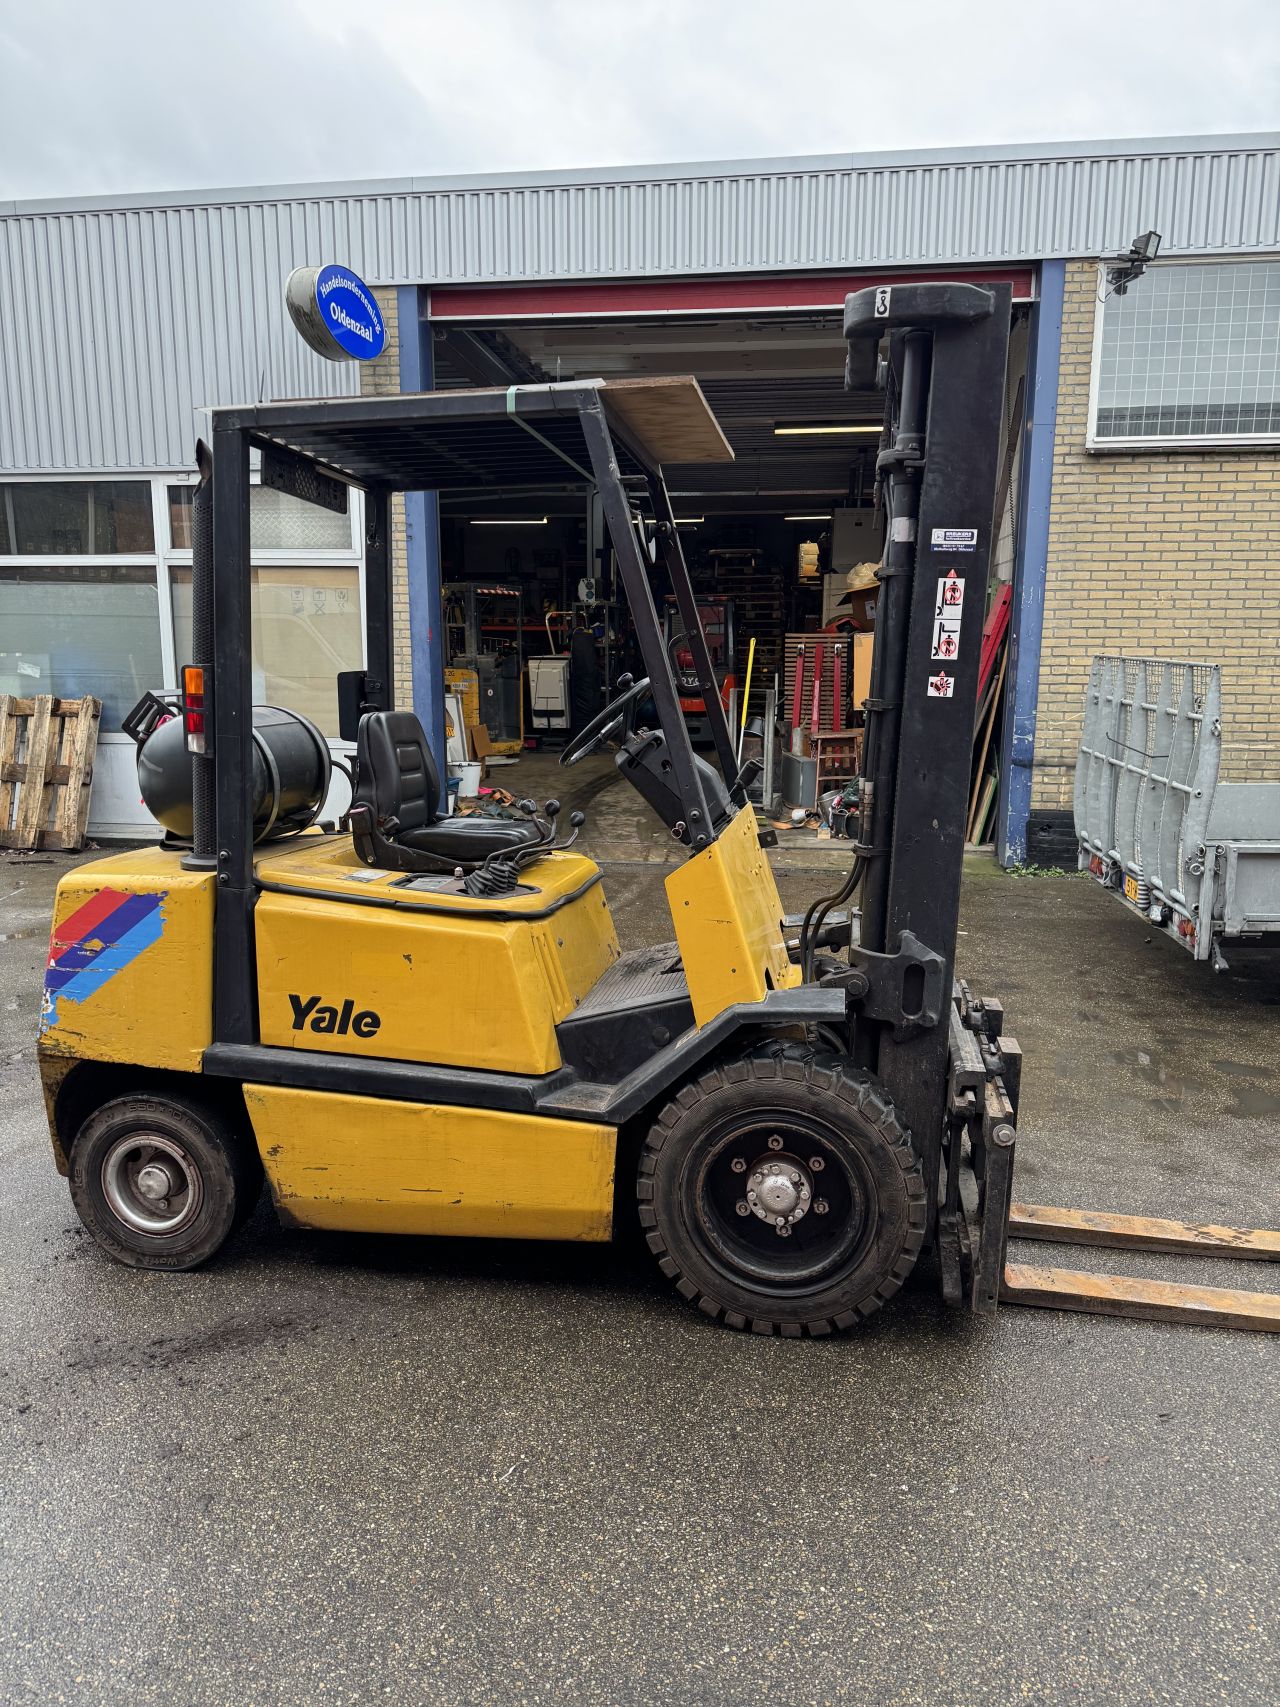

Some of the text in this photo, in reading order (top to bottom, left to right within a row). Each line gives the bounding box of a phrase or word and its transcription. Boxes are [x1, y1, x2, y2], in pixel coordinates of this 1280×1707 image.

[320, 274, 382, 335] Handelsonderneming
[330, 302, 373, 342] Oldenzaal
[288, 993, 382, 1038] Yale
